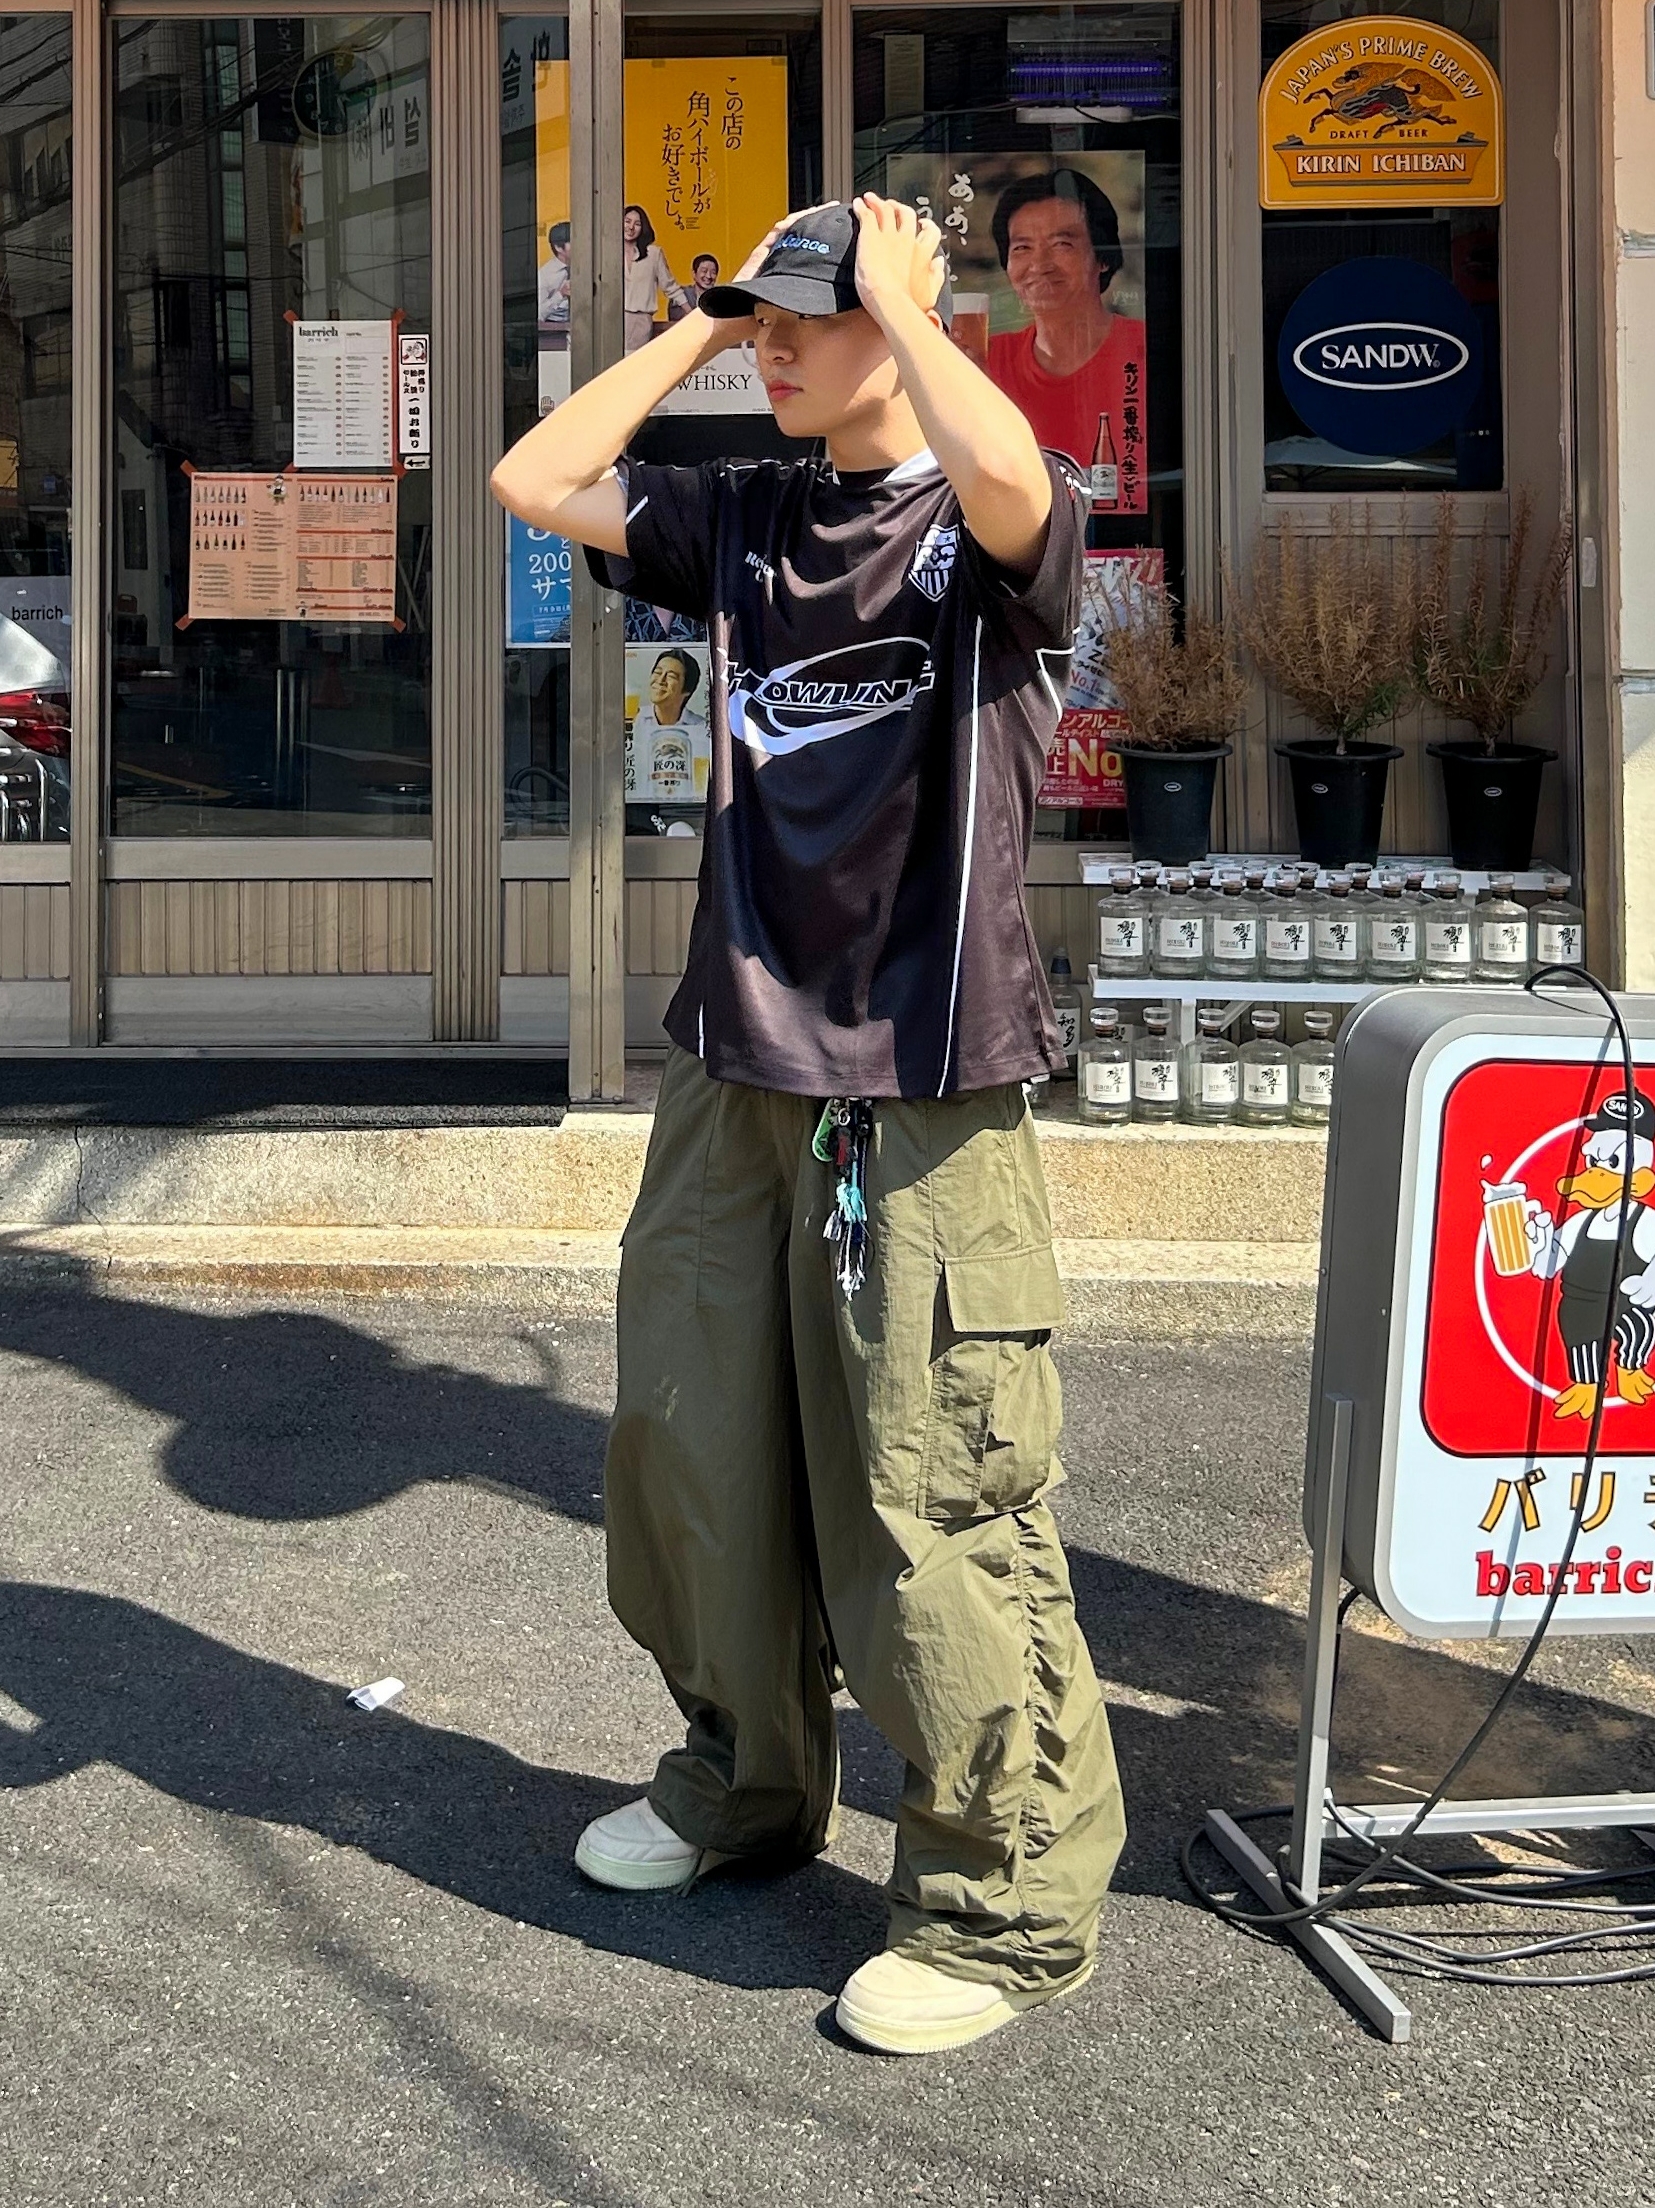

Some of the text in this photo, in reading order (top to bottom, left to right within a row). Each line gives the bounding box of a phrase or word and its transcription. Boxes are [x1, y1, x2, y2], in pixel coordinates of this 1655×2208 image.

[1280, 36, 1484, 104] JAPAN'S PRIME BREW
[722, 76, 744, 150] この店の
[1330, 128, 1428, 139] DRAFT BEER
[687, 90, 711, 214] 角ハイボールが
[1297, 153, 1466, 173] KIRIN ICHIBAN
[661, 124, 686, 231] お好きでしょ。
[298, 325, 339, 337] barrich
[678, 374, 752, 390] WHISKY
[12, 606, 63, 621] barrich
[1058, 1012, 1075, 1048] 知多
